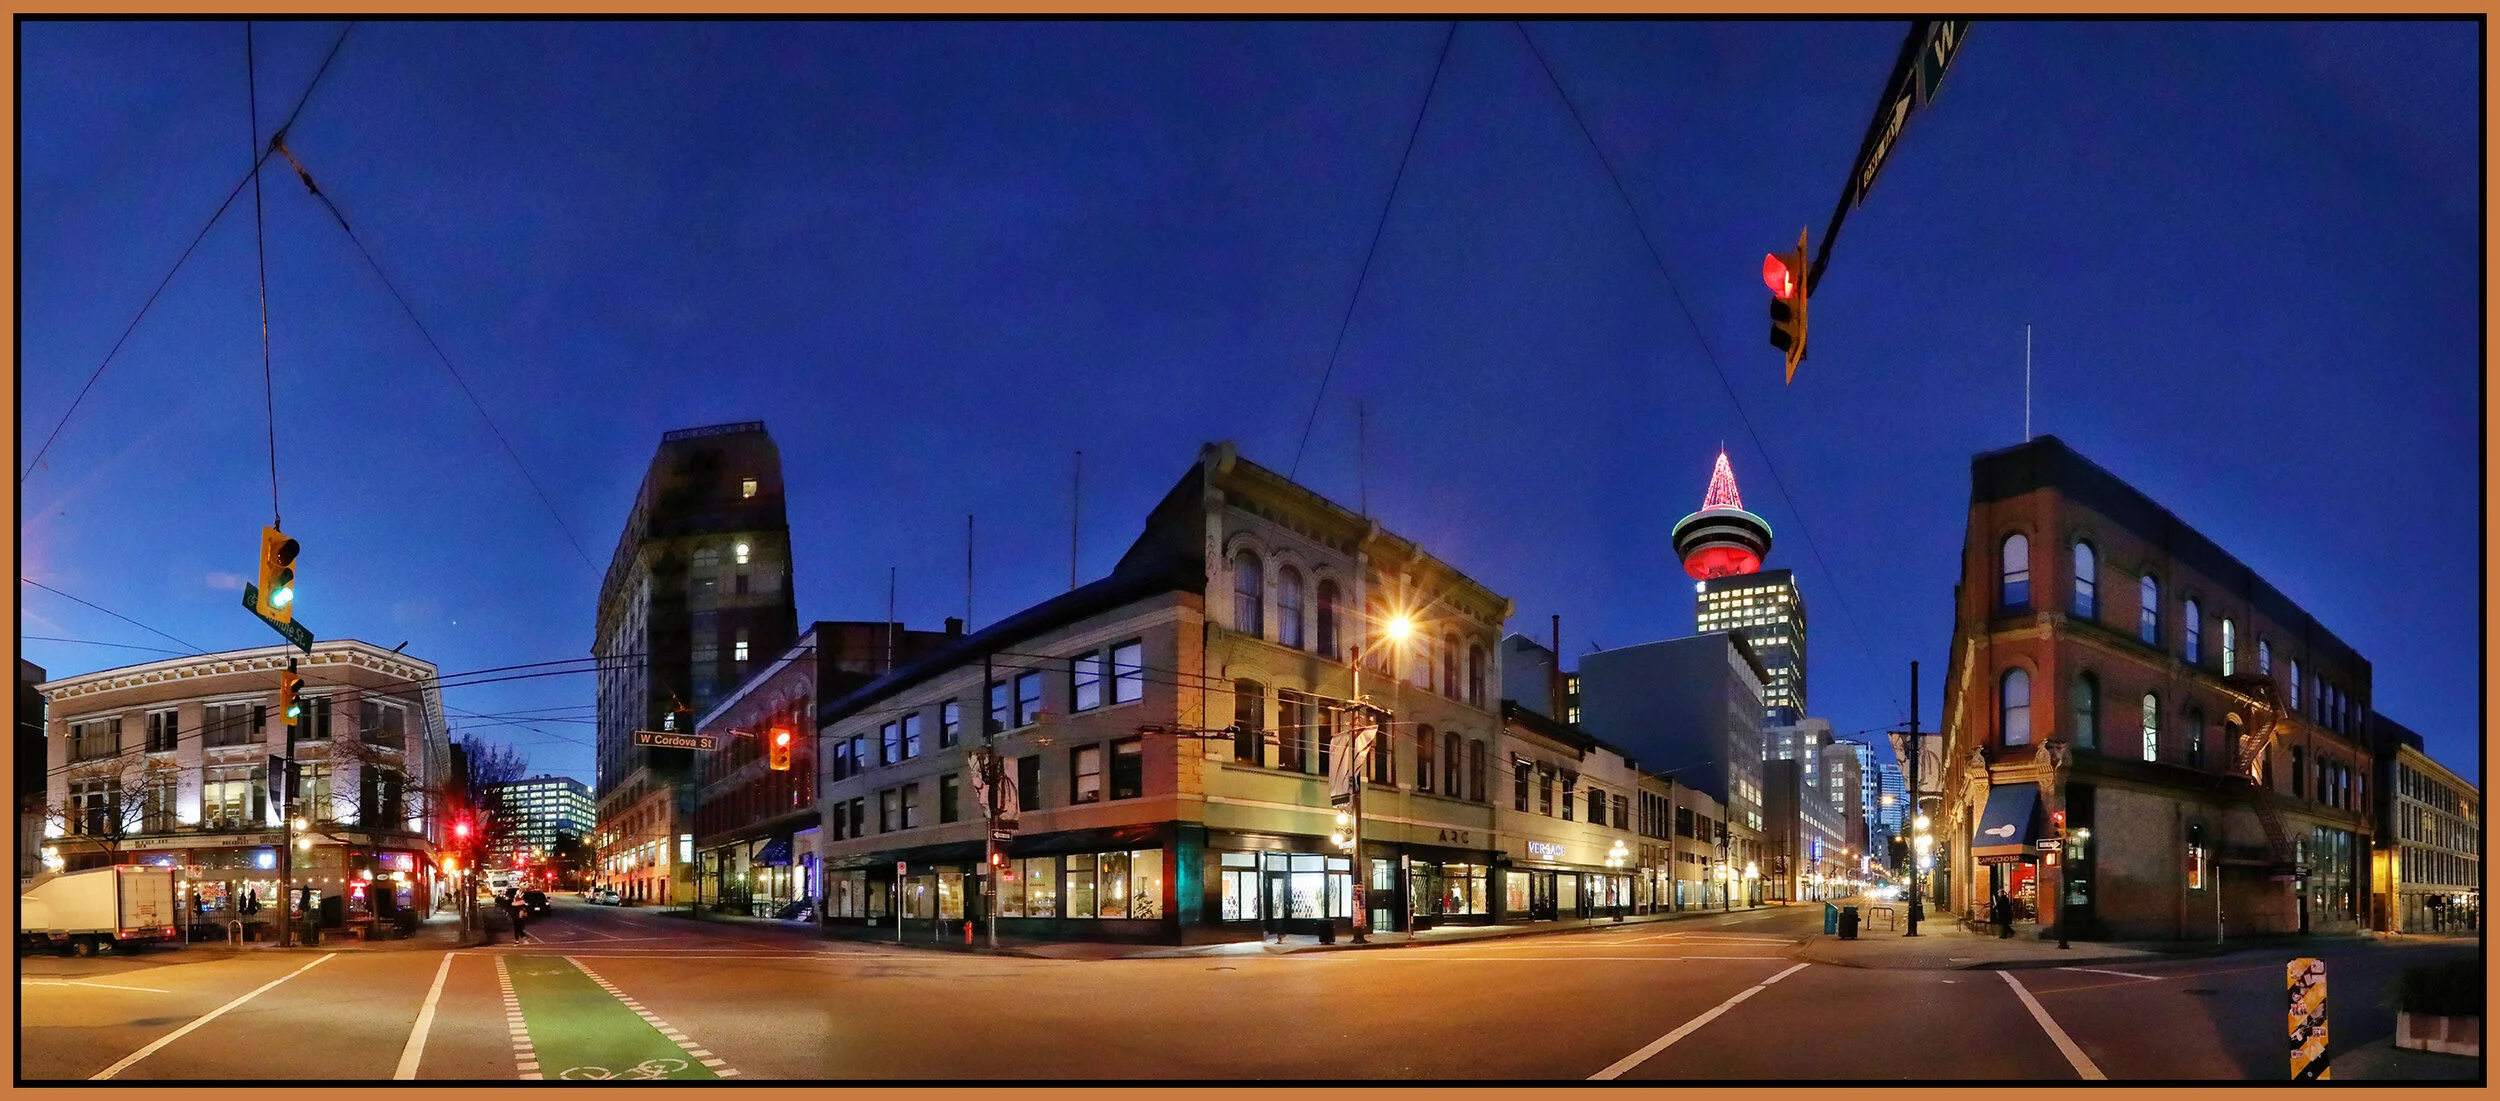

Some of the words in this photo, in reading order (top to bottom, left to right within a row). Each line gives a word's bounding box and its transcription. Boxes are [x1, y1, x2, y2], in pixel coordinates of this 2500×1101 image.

[1935, 20, 1955, 68] W
[1864, 153, 1880, 183] ONE
[640, 734, 651, 743] W
[654, 734, 696, 747] Cordova
[700, 738, 712, 748] St
[1978, 856, 2009, 864] CAPPUCCINO
